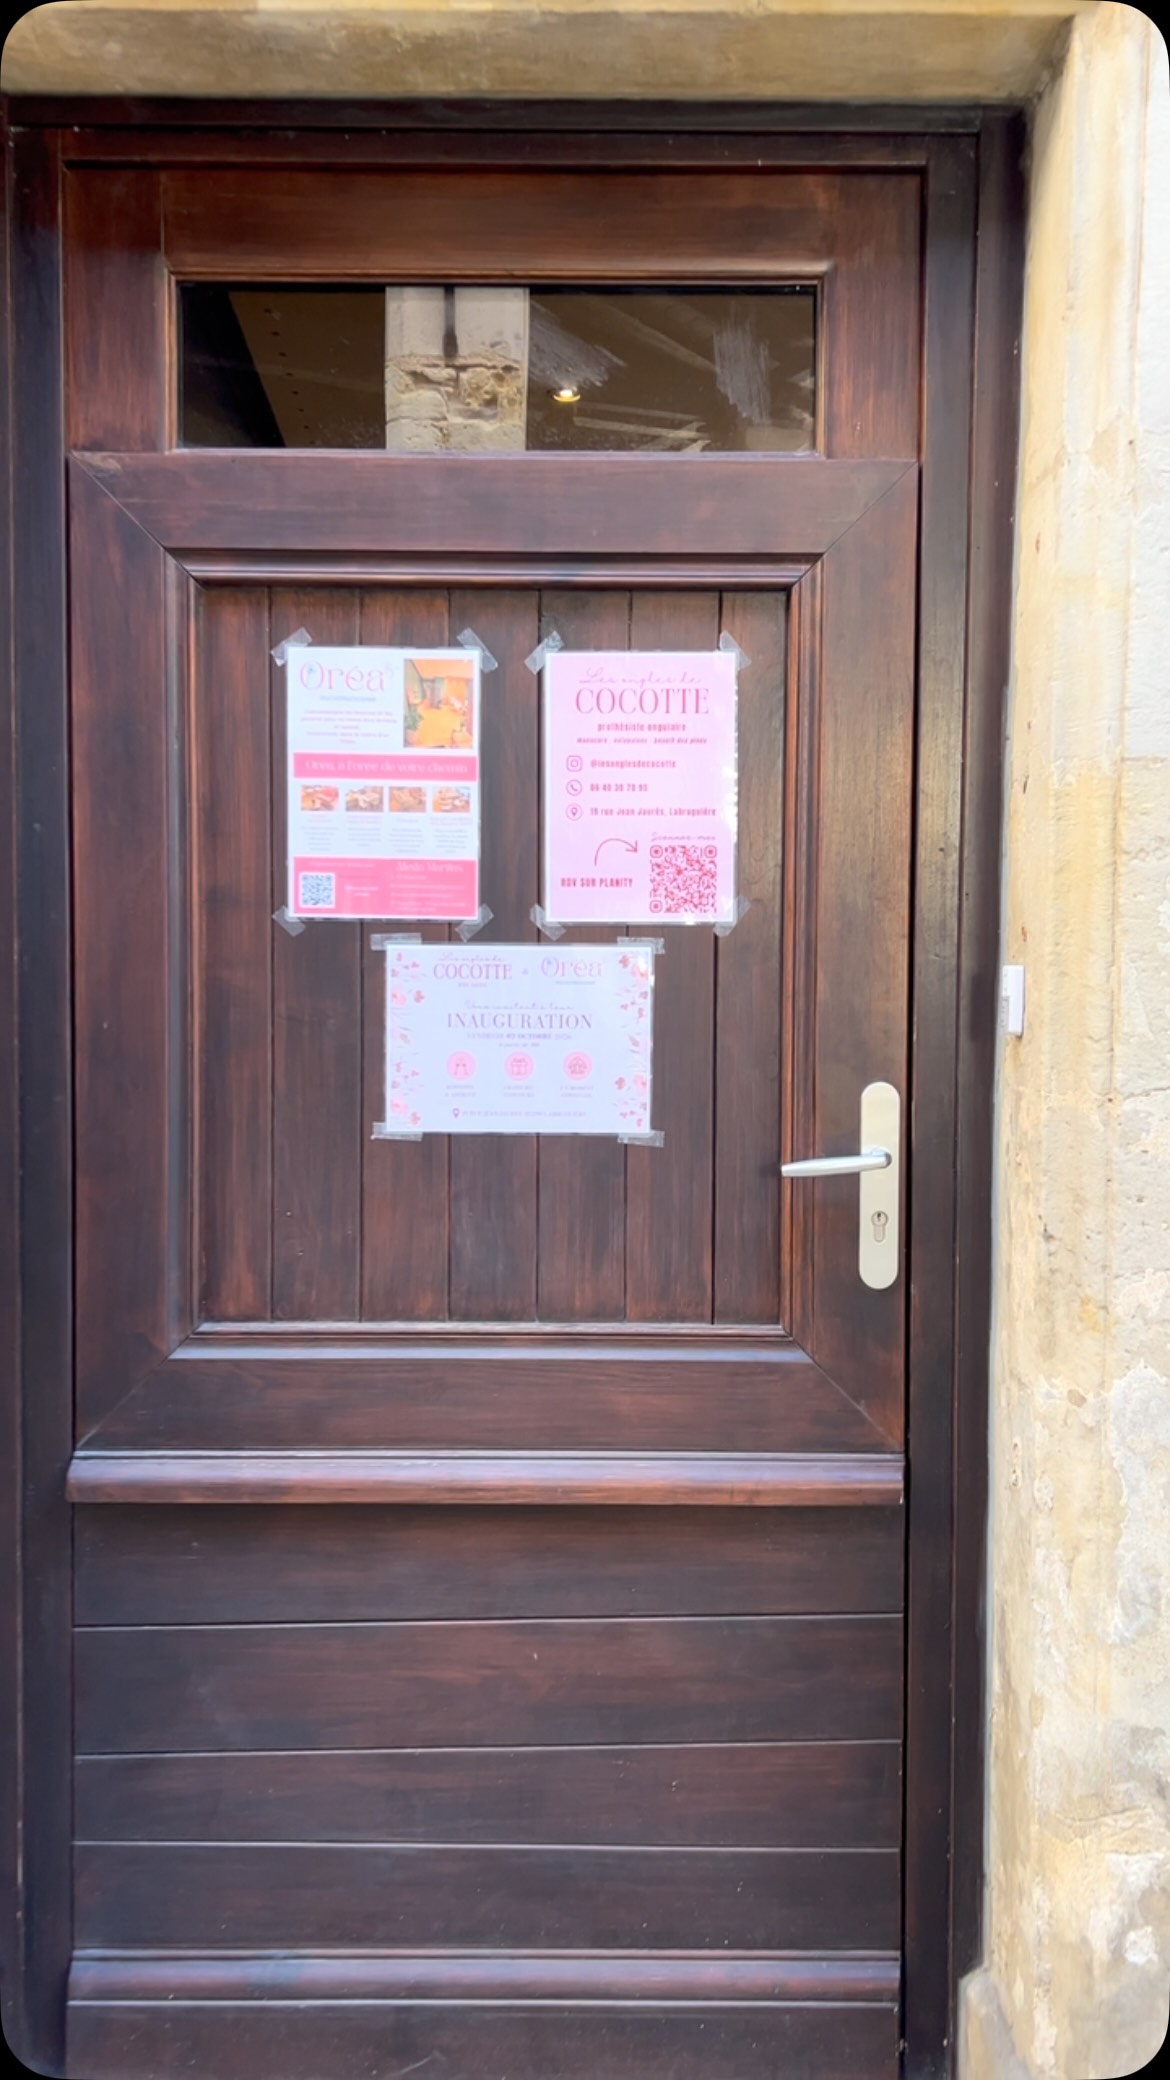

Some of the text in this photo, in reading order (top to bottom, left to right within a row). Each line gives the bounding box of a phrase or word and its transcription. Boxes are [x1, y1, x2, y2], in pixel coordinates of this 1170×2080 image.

[300, 661, 385, 692] Oréa
[579, 667, 617, 683] Les
[679, 672, 702, 683] de
[575, 687, 709, 714] COCOTTE
[601, 808, 614, 816] rue
[616, 807, 635, 816] Jean
[580, 877, 596, 887] SUR
[599, 877, 633, 887] PLANITY
[433, 963, 513, 980] COCOTTE
[447, 1013, 593, 1030] INAUGURATION
